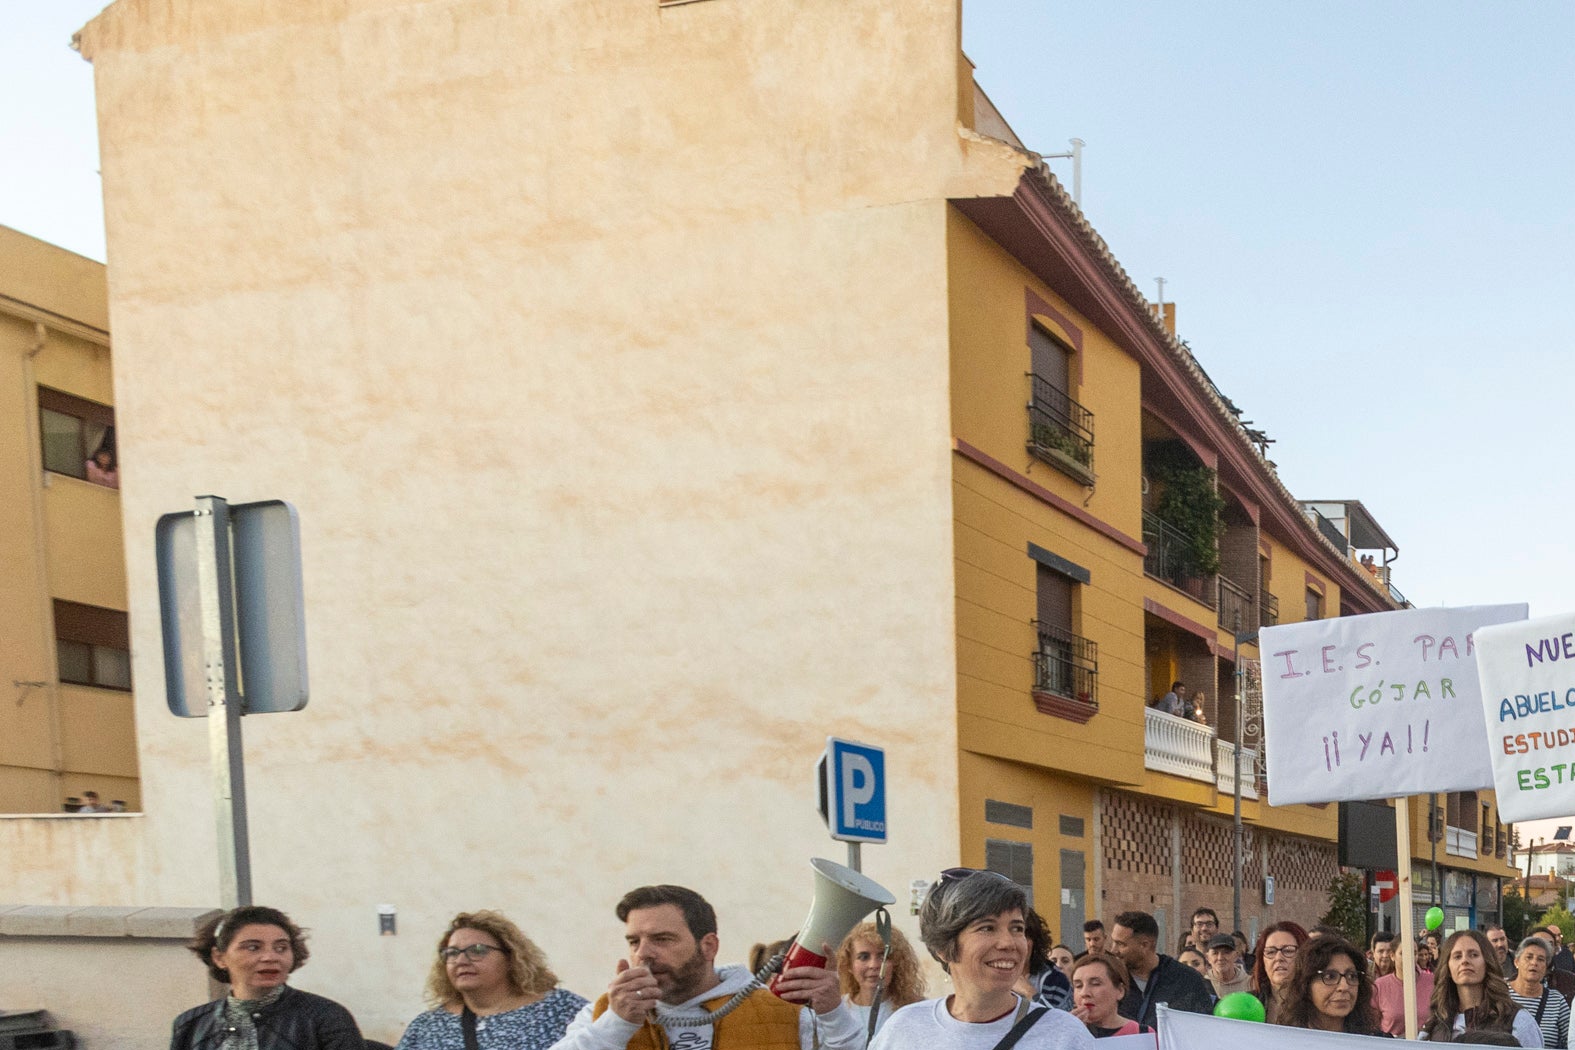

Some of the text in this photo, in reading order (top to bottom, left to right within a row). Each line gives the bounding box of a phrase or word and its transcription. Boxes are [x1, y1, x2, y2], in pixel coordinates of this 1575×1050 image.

[1273, 642, 1380, 679] I.E.S.
[1350, 678, 1456, 710] GÓJAR
[841, 750, 876, 828] P
